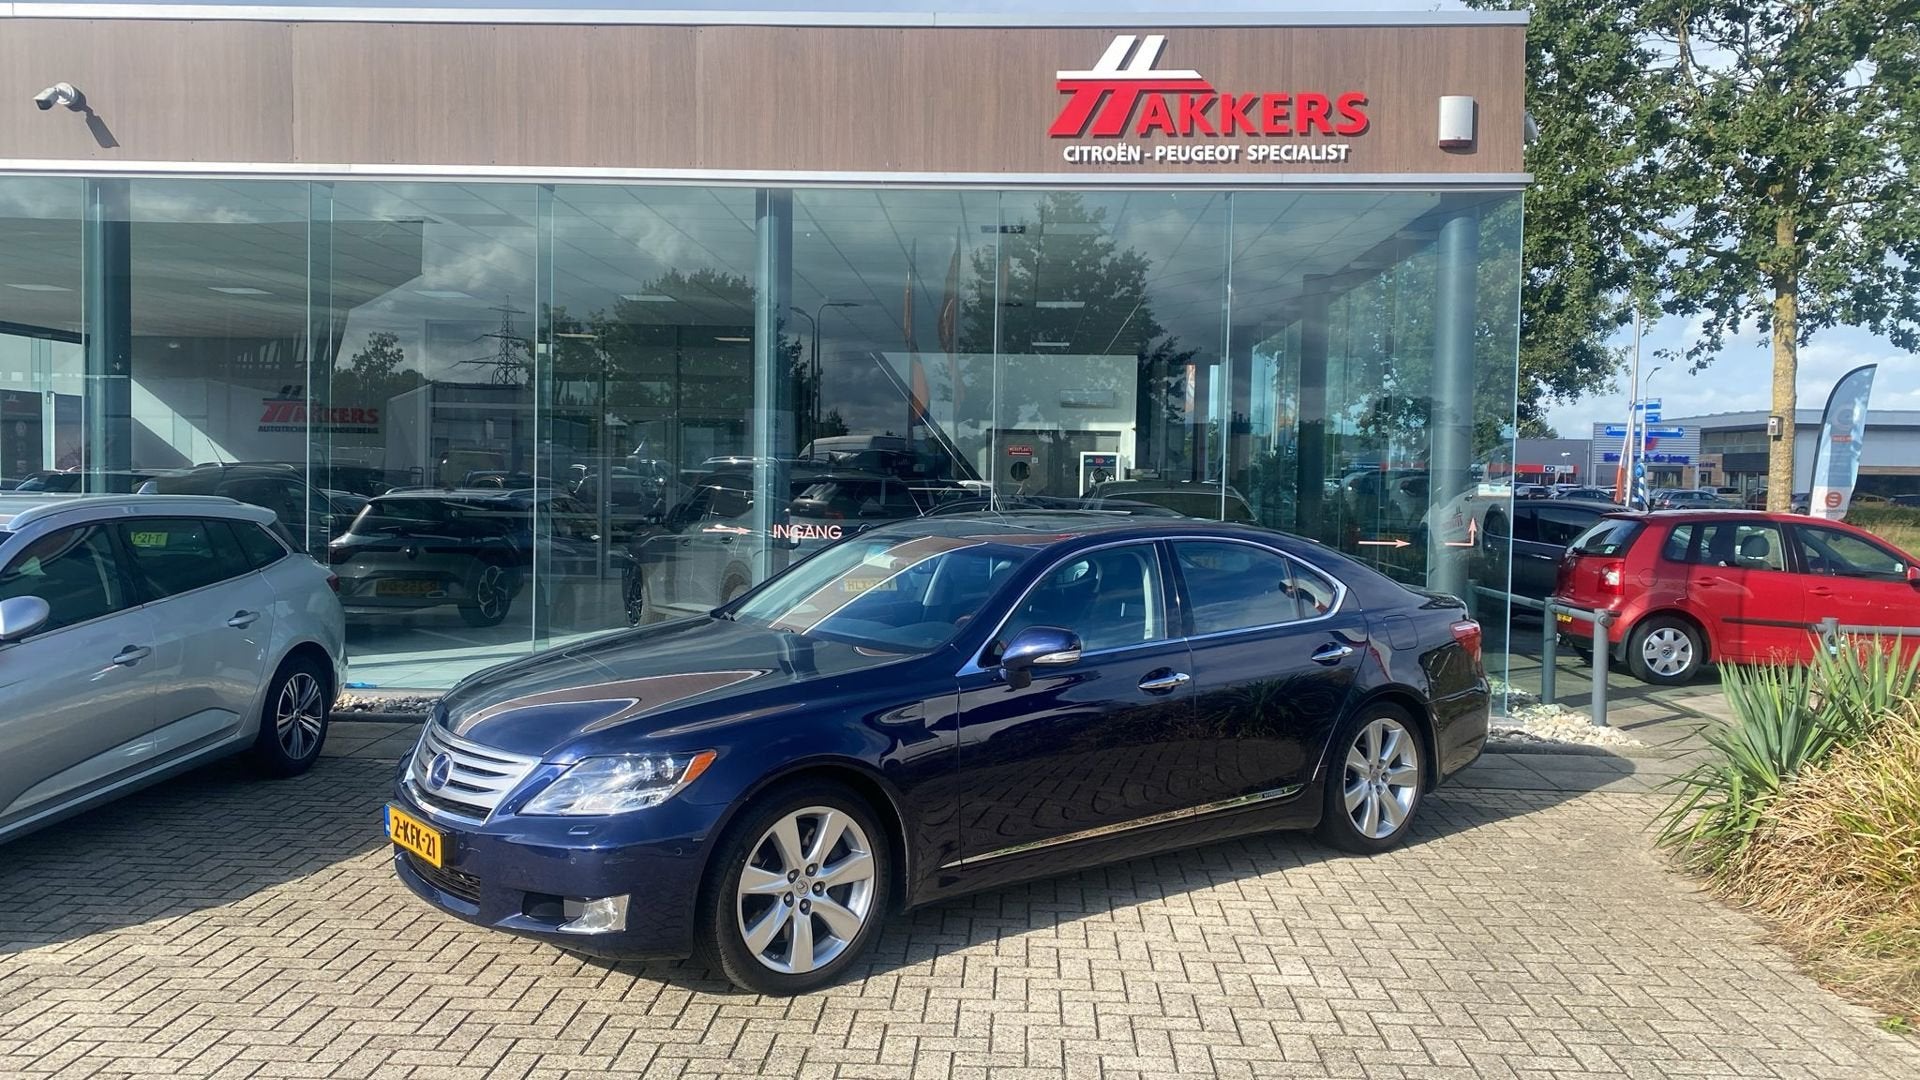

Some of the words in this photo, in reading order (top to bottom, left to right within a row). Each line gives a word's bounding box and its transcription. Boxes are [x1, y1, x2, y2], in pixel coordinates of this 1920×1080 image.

[1048, 35, 1369, 136] HAKKERS
[1063, 142, 1141, 162] CITROËN
[1155, 145, 1240, 162] PEUGEOT
[1247, 143, 1349, 161] SPECIALIST
[773, 524, 842, 539] INGANG
[393, 816, 436, 860] 2-KFK-21
